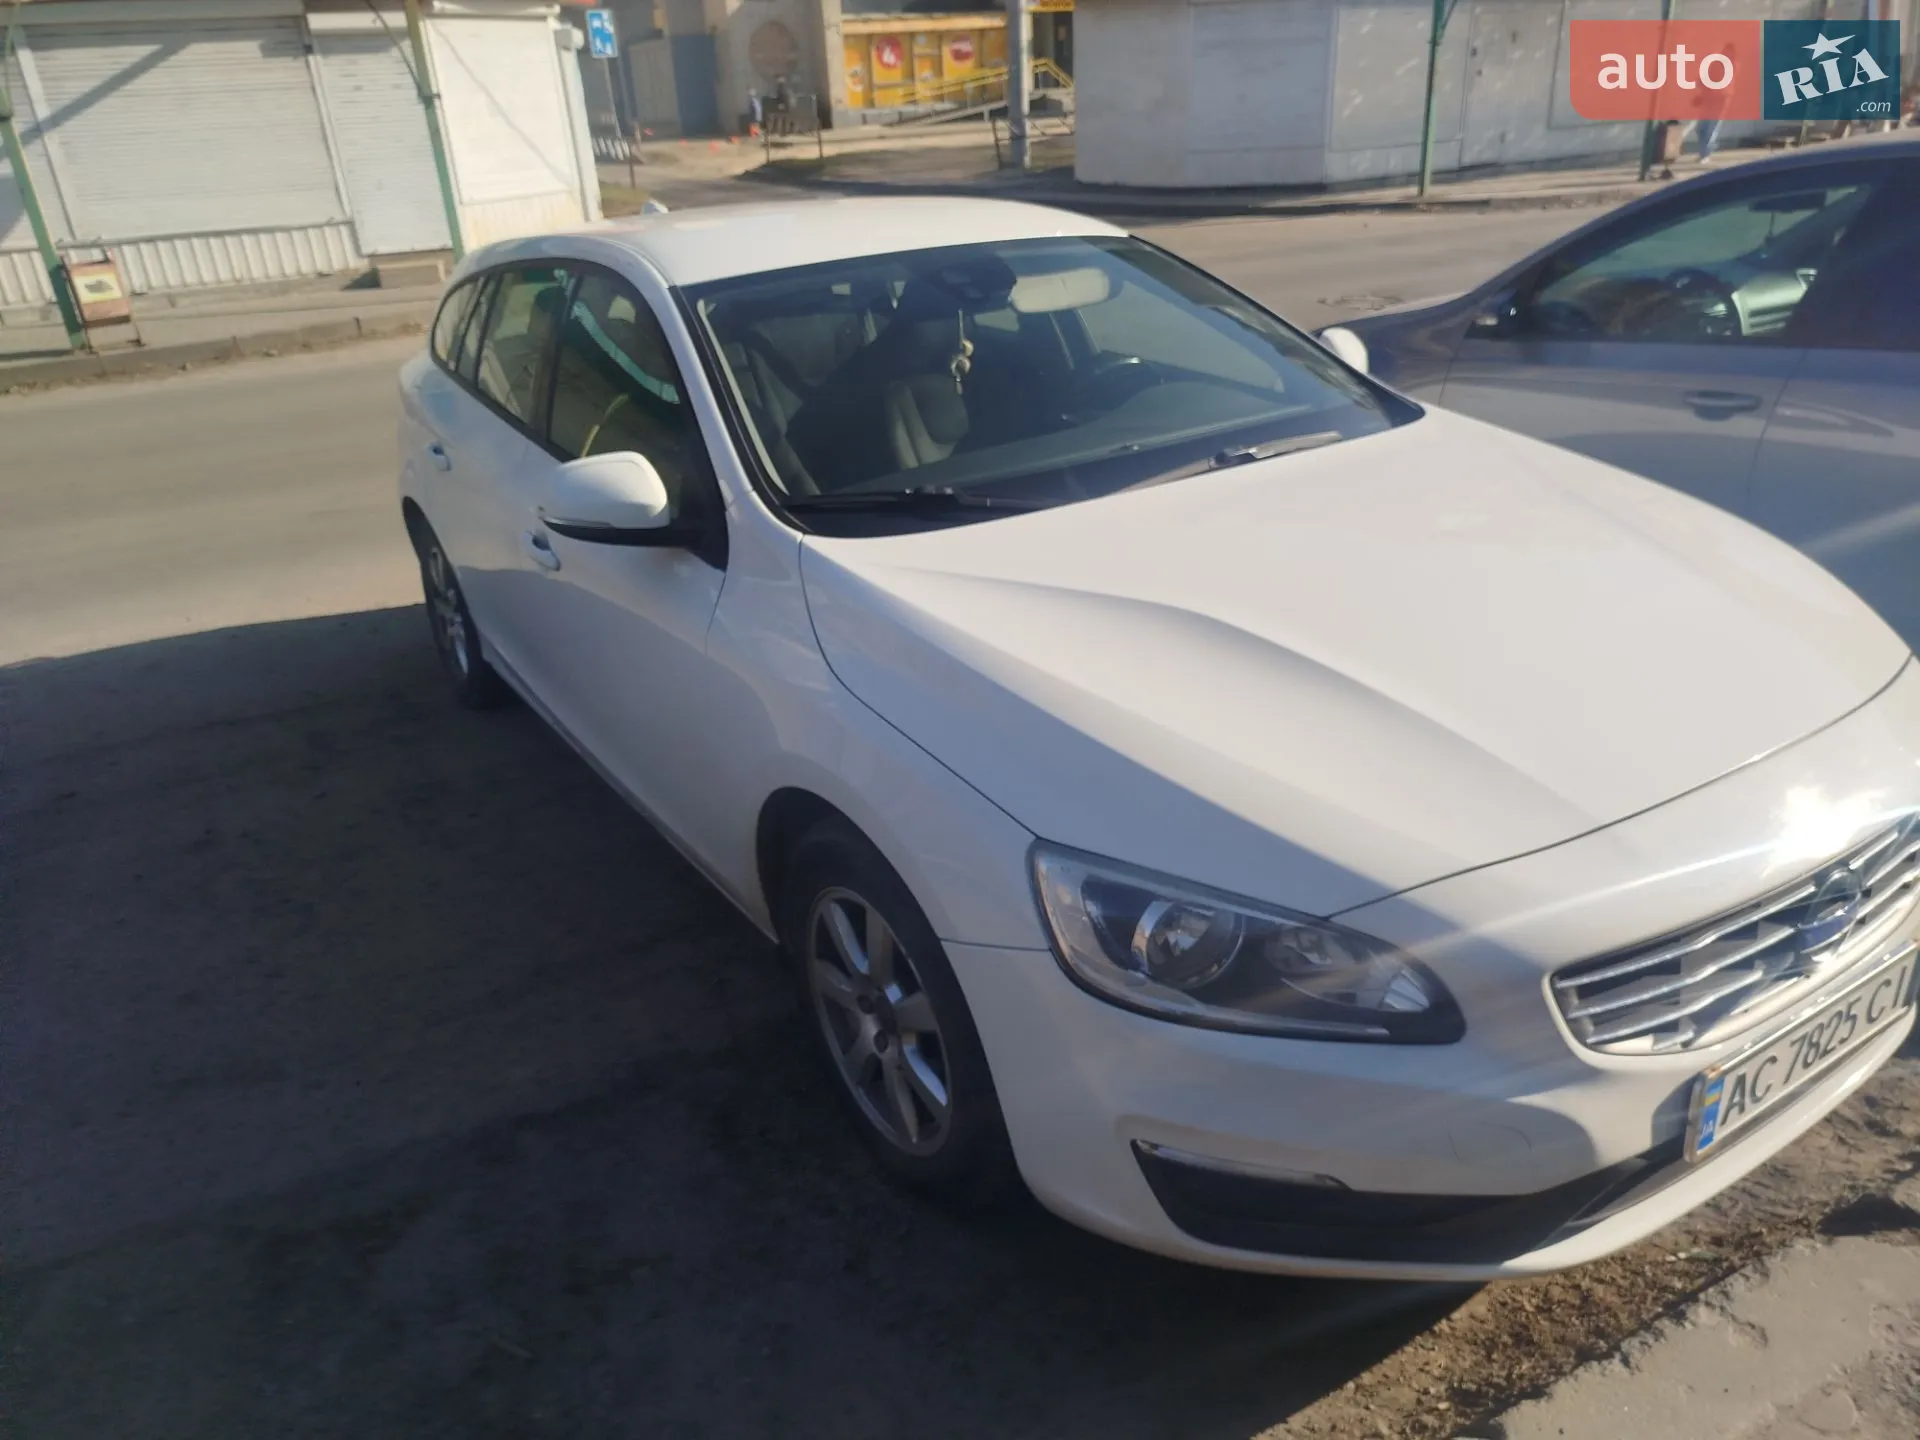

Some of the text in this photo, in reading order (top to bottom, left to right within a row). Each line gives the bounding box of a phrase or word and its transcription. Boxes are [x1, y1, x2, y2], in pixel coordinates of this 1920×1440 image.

[1719, 964, 1908, 1128] AC 7825 CI
